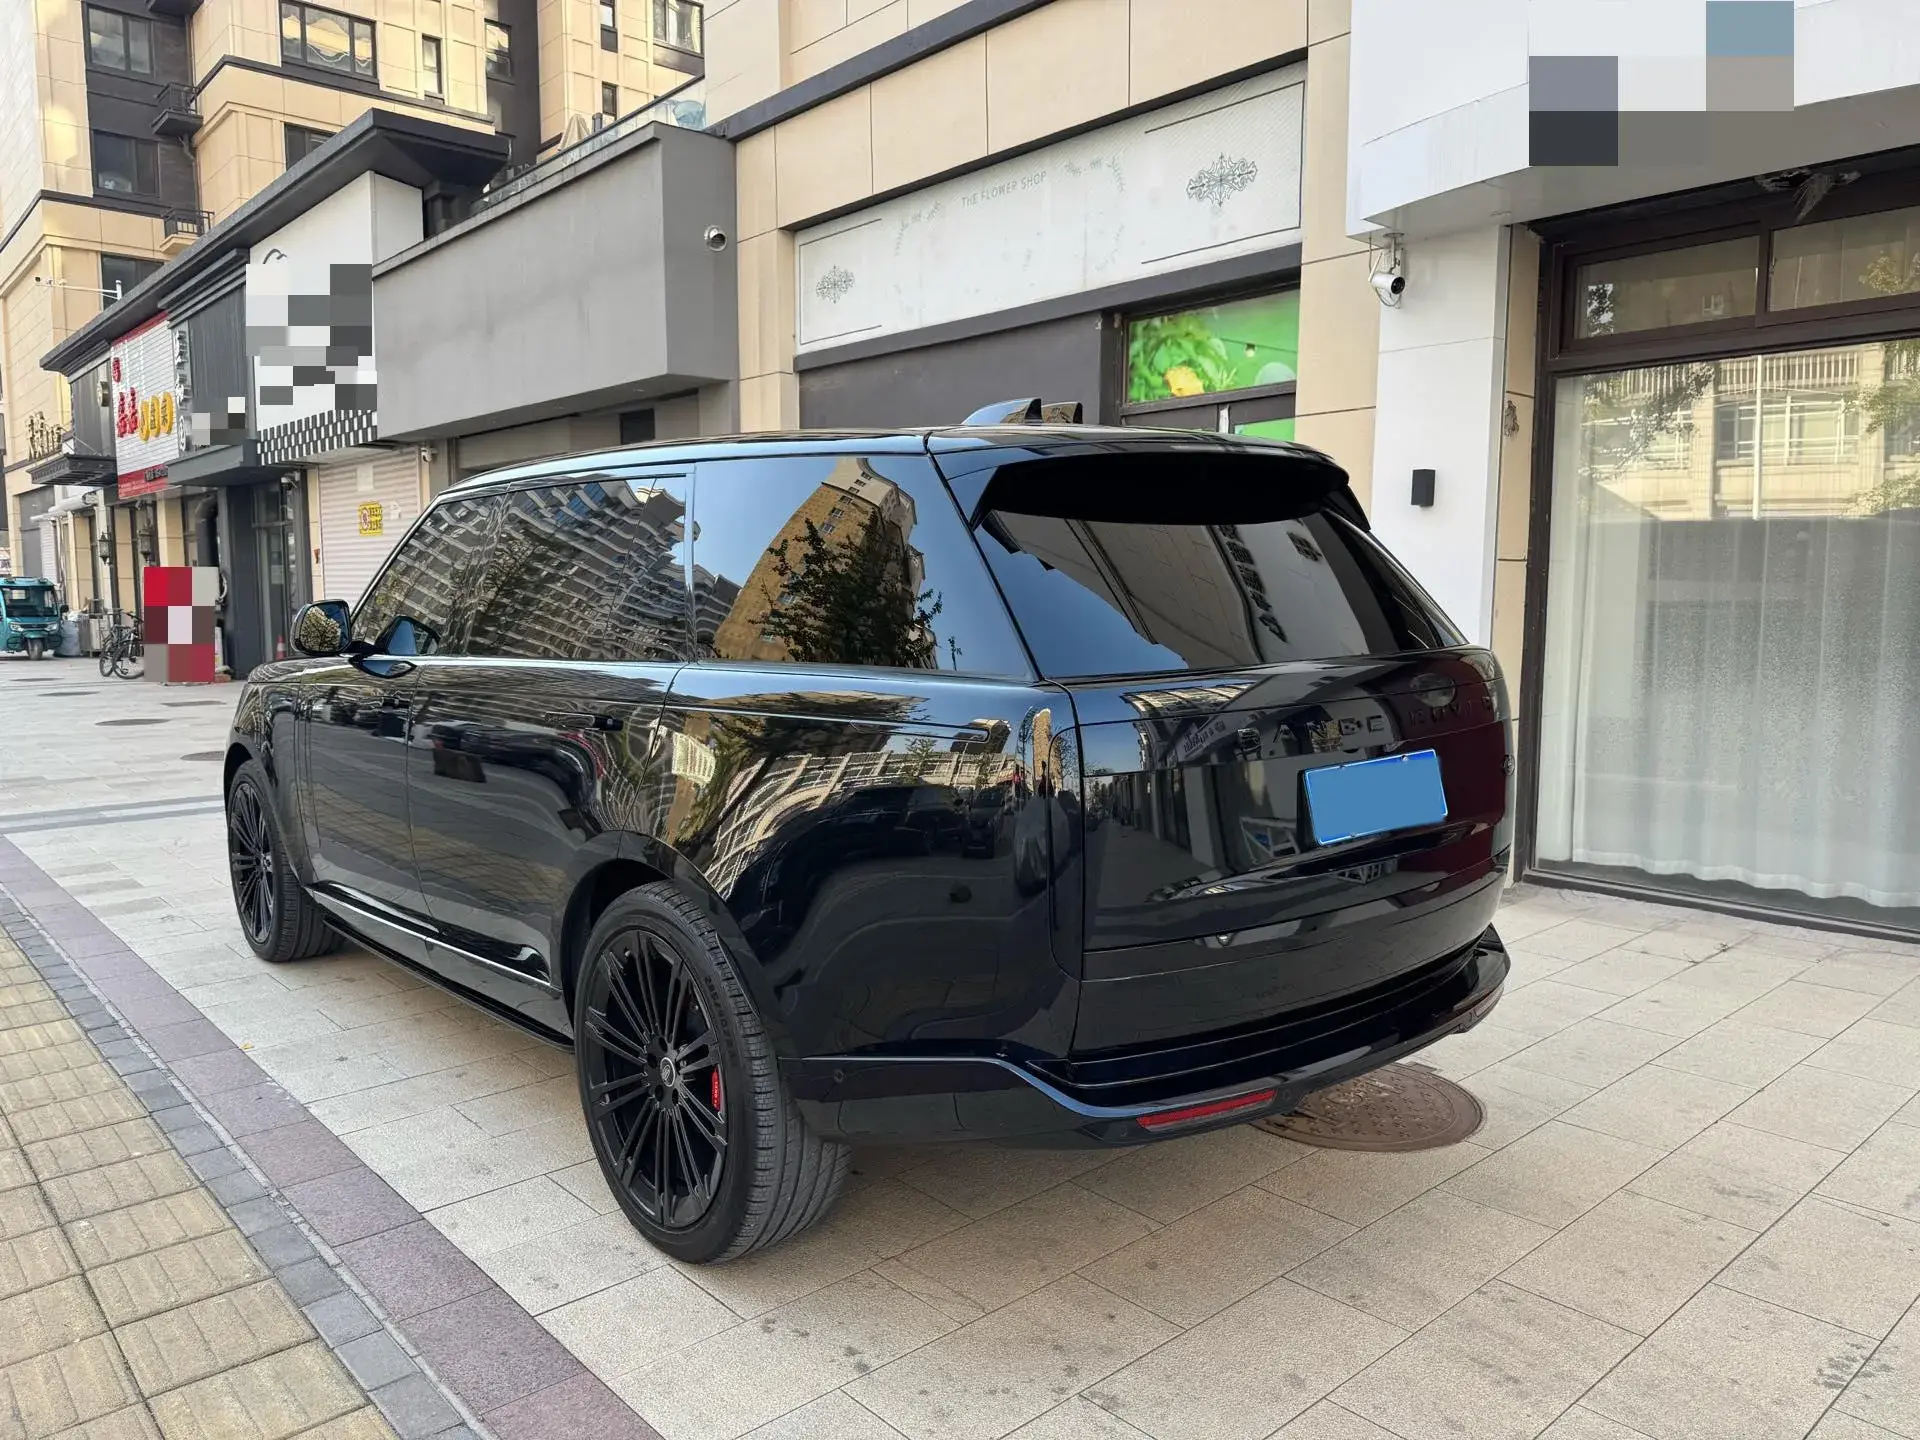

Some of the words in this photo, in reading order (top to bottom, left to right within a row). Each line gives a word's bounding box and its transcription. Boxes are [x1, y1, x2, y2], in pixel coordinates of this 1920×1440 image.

[961, 192, 978, 207] THE
[981, 180, 1017, 201] FLOWER
[1020, 170, 1047, 190] SHOP
